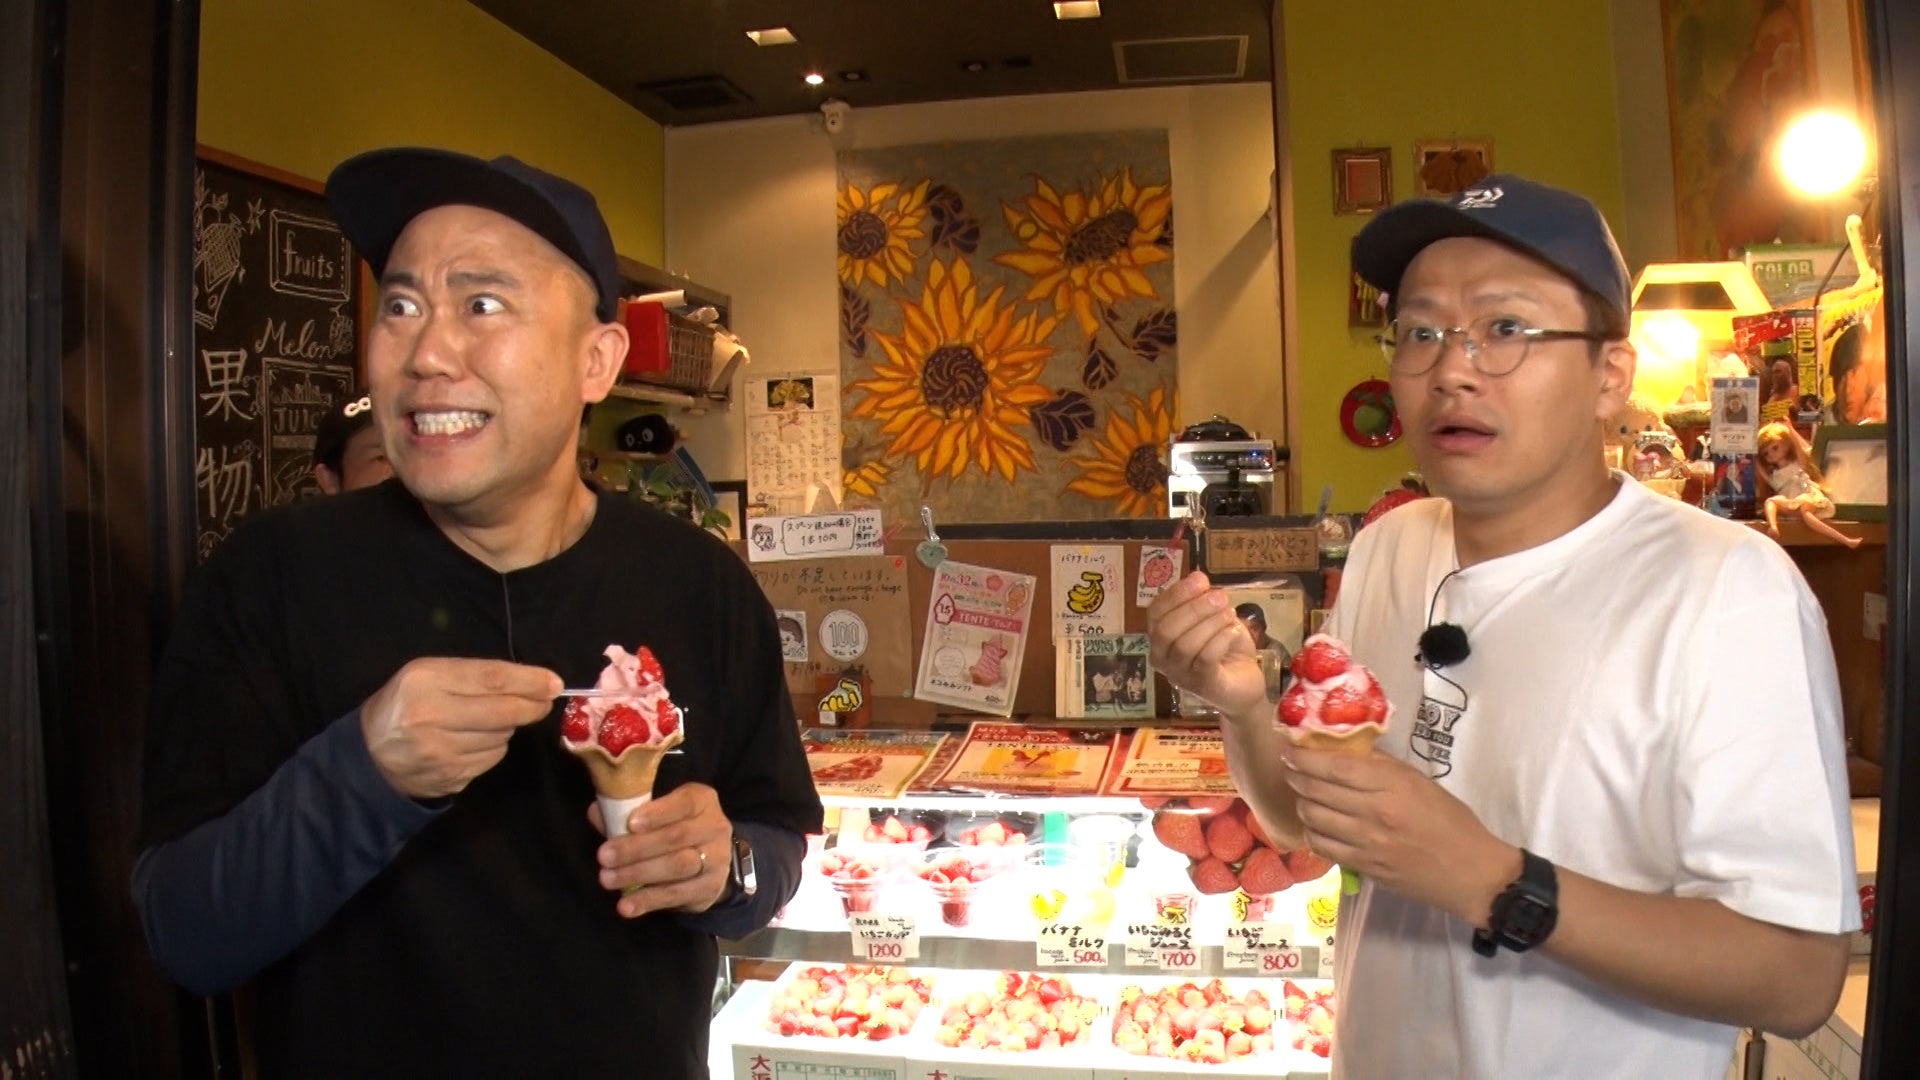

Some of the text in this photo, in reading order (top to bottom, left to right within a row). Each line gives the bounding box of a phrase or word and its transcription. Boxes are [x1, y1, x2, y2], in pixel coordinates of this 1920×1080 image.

[284, 231, 334, 278] fruits
[255, 317, 338, 360] Melon
[196, 348, 255, 519] 果物
[829, 621, 860, 648] 100
[1041, 924, 1082, 935] バナナ
[1128, 925, 1192, 939] いちごみるく
[1228, 927, 1264, 938] いちご
[1068, 937, 1105, 948] ミルク
[1150, 937, 1192, 949] ジュース
[1246, 938, 1289, 949] ジュース
[868, 943, 902, 958] 1200
[1263, 953, 1299, 970] 800
